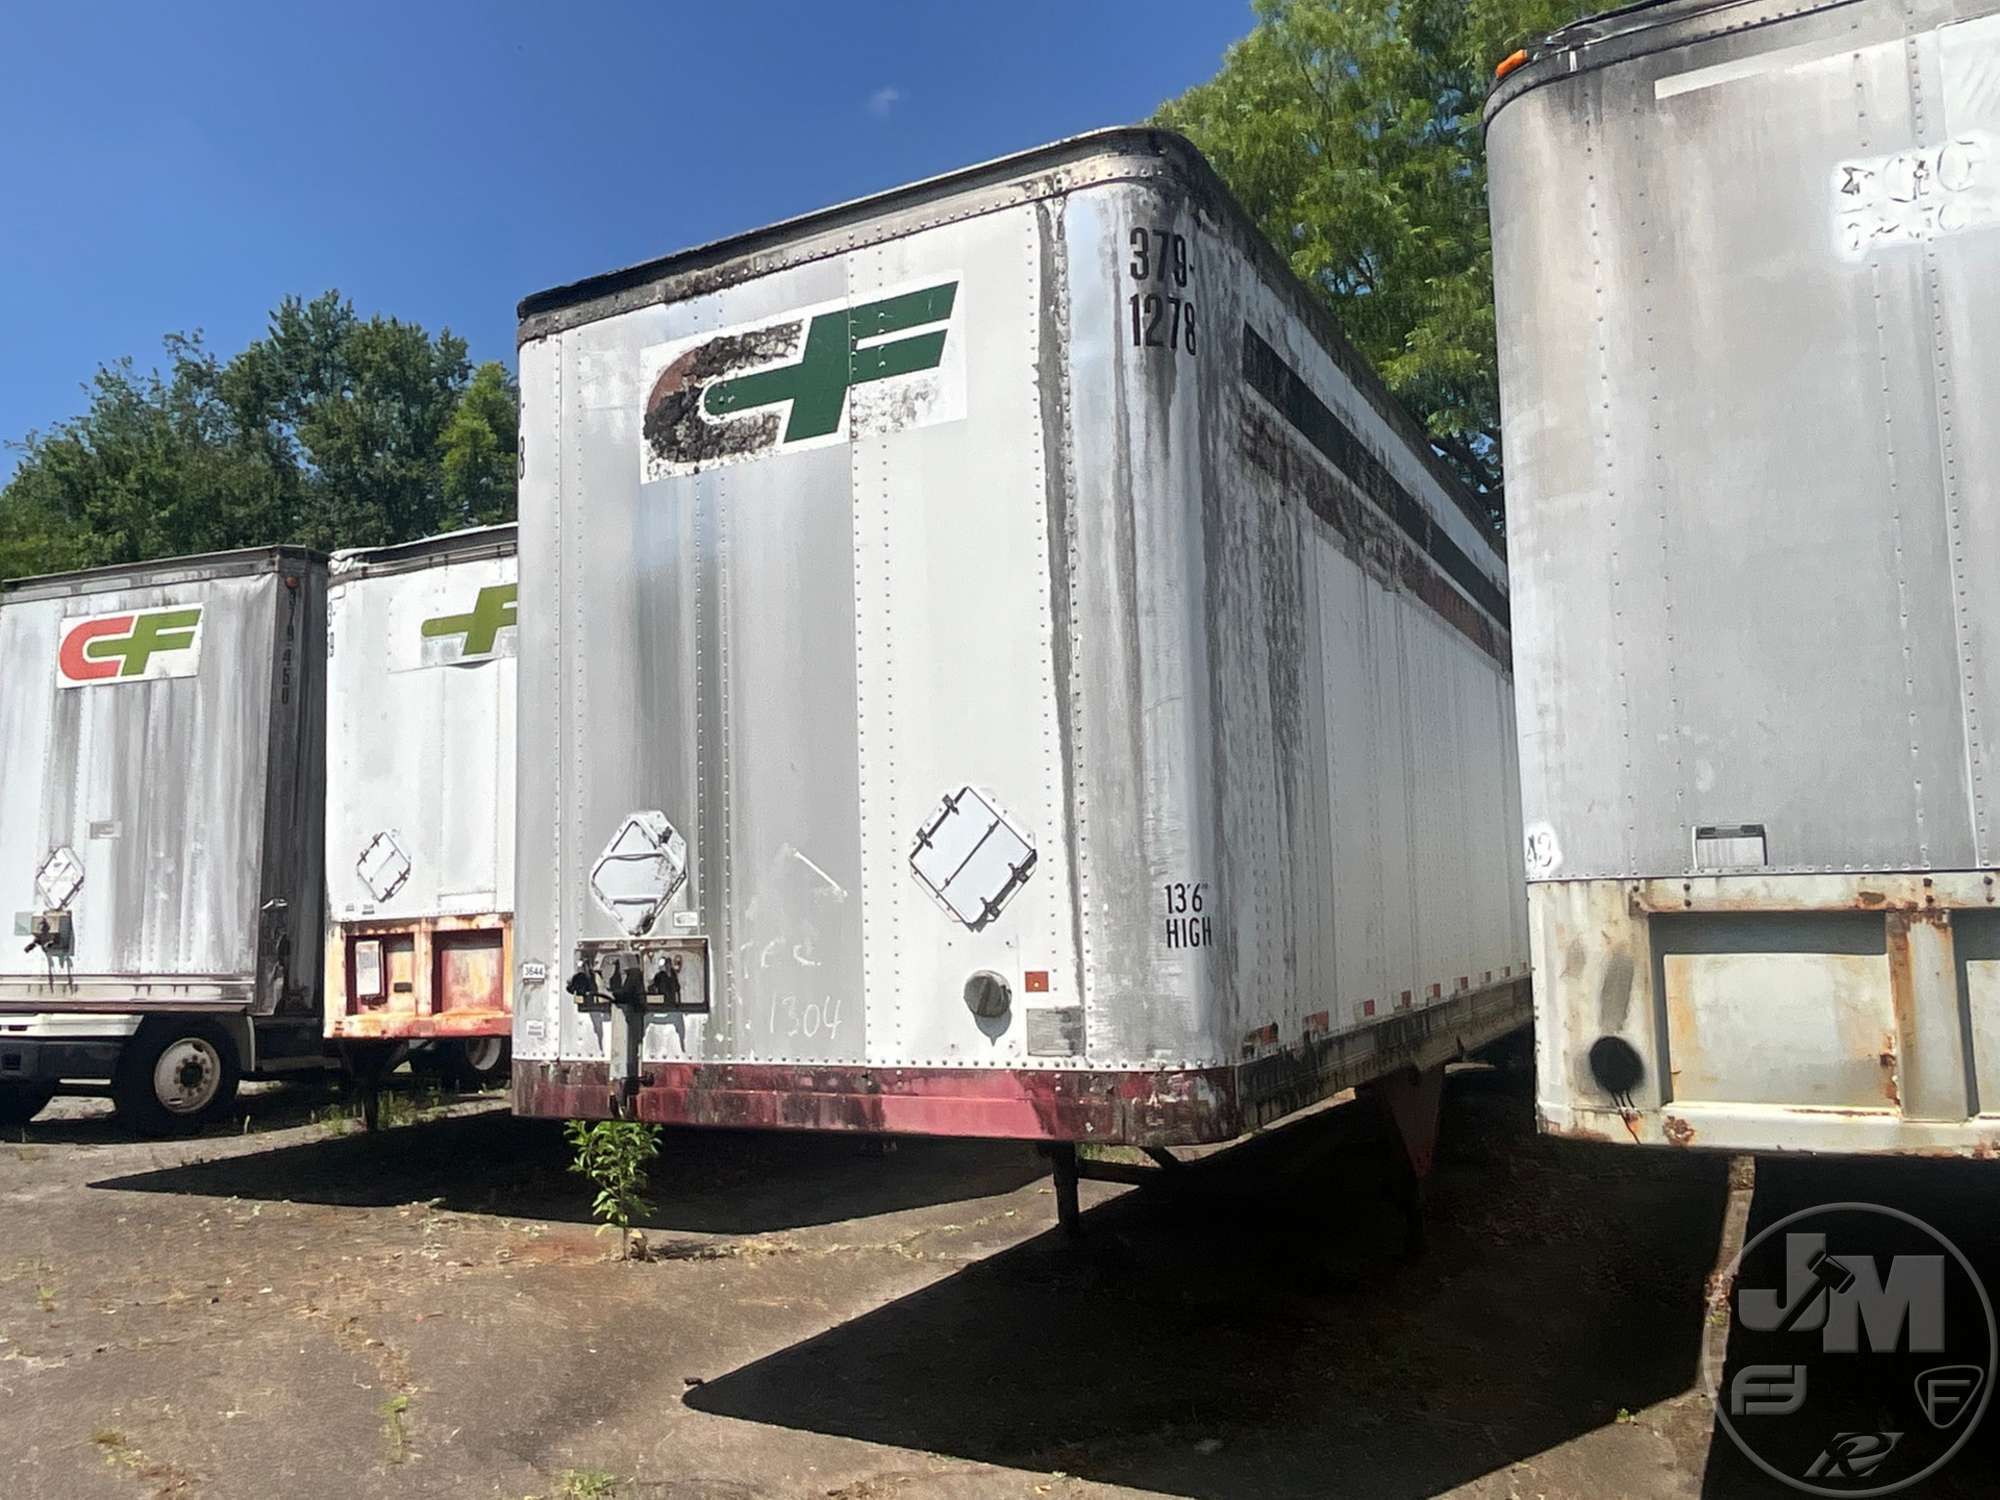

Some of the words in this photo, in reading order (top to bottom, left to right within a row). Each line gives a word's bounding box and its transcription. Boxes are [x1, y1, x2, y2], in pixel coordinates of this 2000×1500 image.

[1129, 294, 1196, 356] 1278
[644, 281, 958, 464] CF
[59, 609, 201, 680] CF
[1166, 916, 1212, 948] HIGH
[769, 992, 842, 1039] 1304
